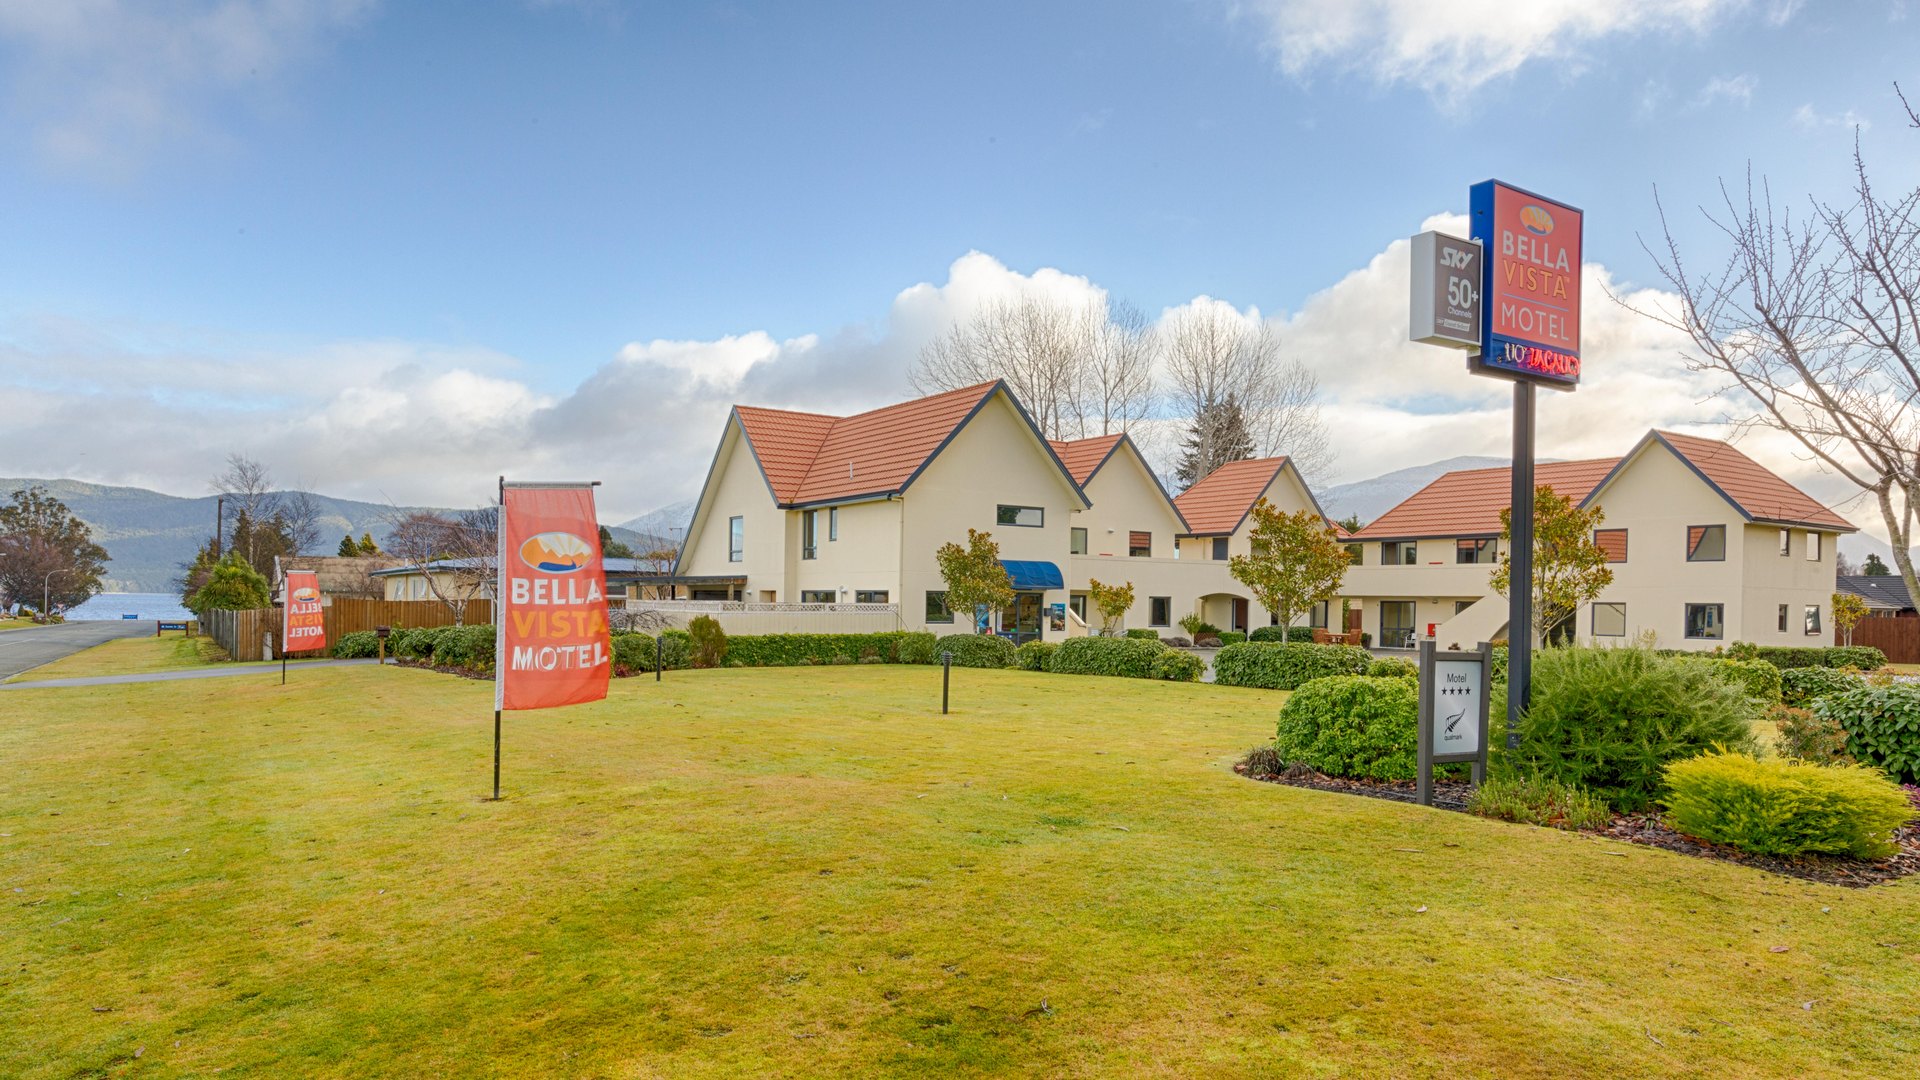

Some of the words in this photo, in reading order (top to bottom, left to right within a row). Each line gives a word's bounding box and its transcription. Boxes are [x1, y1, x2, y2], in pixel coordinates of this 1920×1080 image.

[1440, 246, 1473, 270] SKY
[1502, 230, 1570, 273] BELLA
[1447, 276, 1478, 309] 50+
[1503, 259, 1568, 300] VISTA
[1447, 305, 1472, 319] Channels
[1501, 302, 1568, 341] MOTEL
[511, 577, 603, 604] BELLA
[512, 610, 607, 638] VISTA
[512, 642, 608, 671] MOTEL
[1446, 673, 1467, 683] Motel
